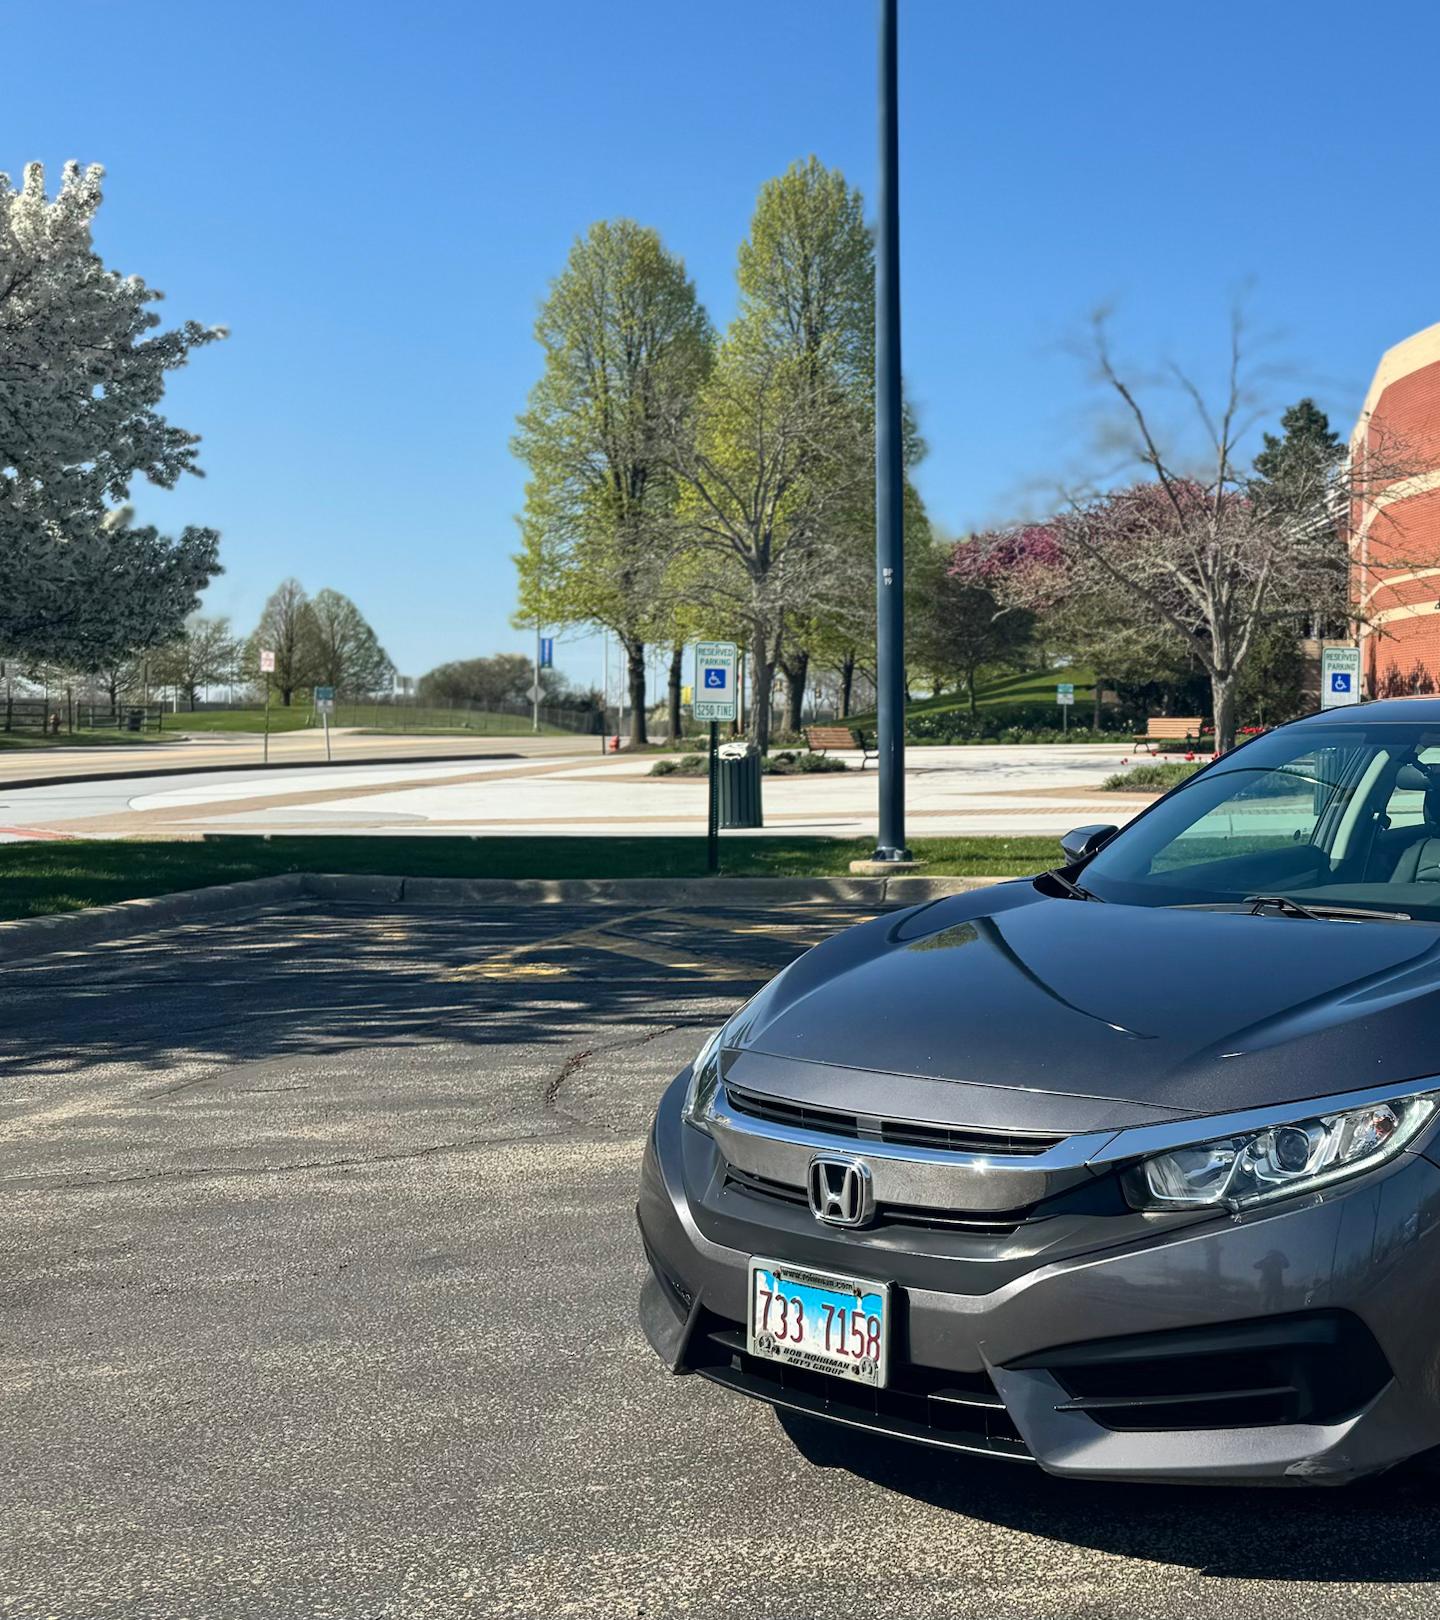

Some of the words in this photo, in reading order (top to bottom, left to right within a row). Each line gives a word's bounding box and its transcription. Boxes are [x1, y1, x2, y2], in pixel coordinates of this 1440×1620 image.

[698, 647, 733, 656] RESERVED
[700, 658, 731, 666] PARKING
[1326, 653, 1358, 661] RESERVED
[1327, 663, 1356, 671] PARKING
[697, 704, 715, 716] $250
[717, 704, 733, 716] FINE
[760, 1290, 803, 1343] 733
[821, 1304, 880, 1364] 7158
[783, 1347, 802, 1358] BOB
[803, 1353, 850, 1370] ROHRMAN
[787, 1356, 811, 1368] AUTO
[812, 1363, 845, 1376] GROUP
